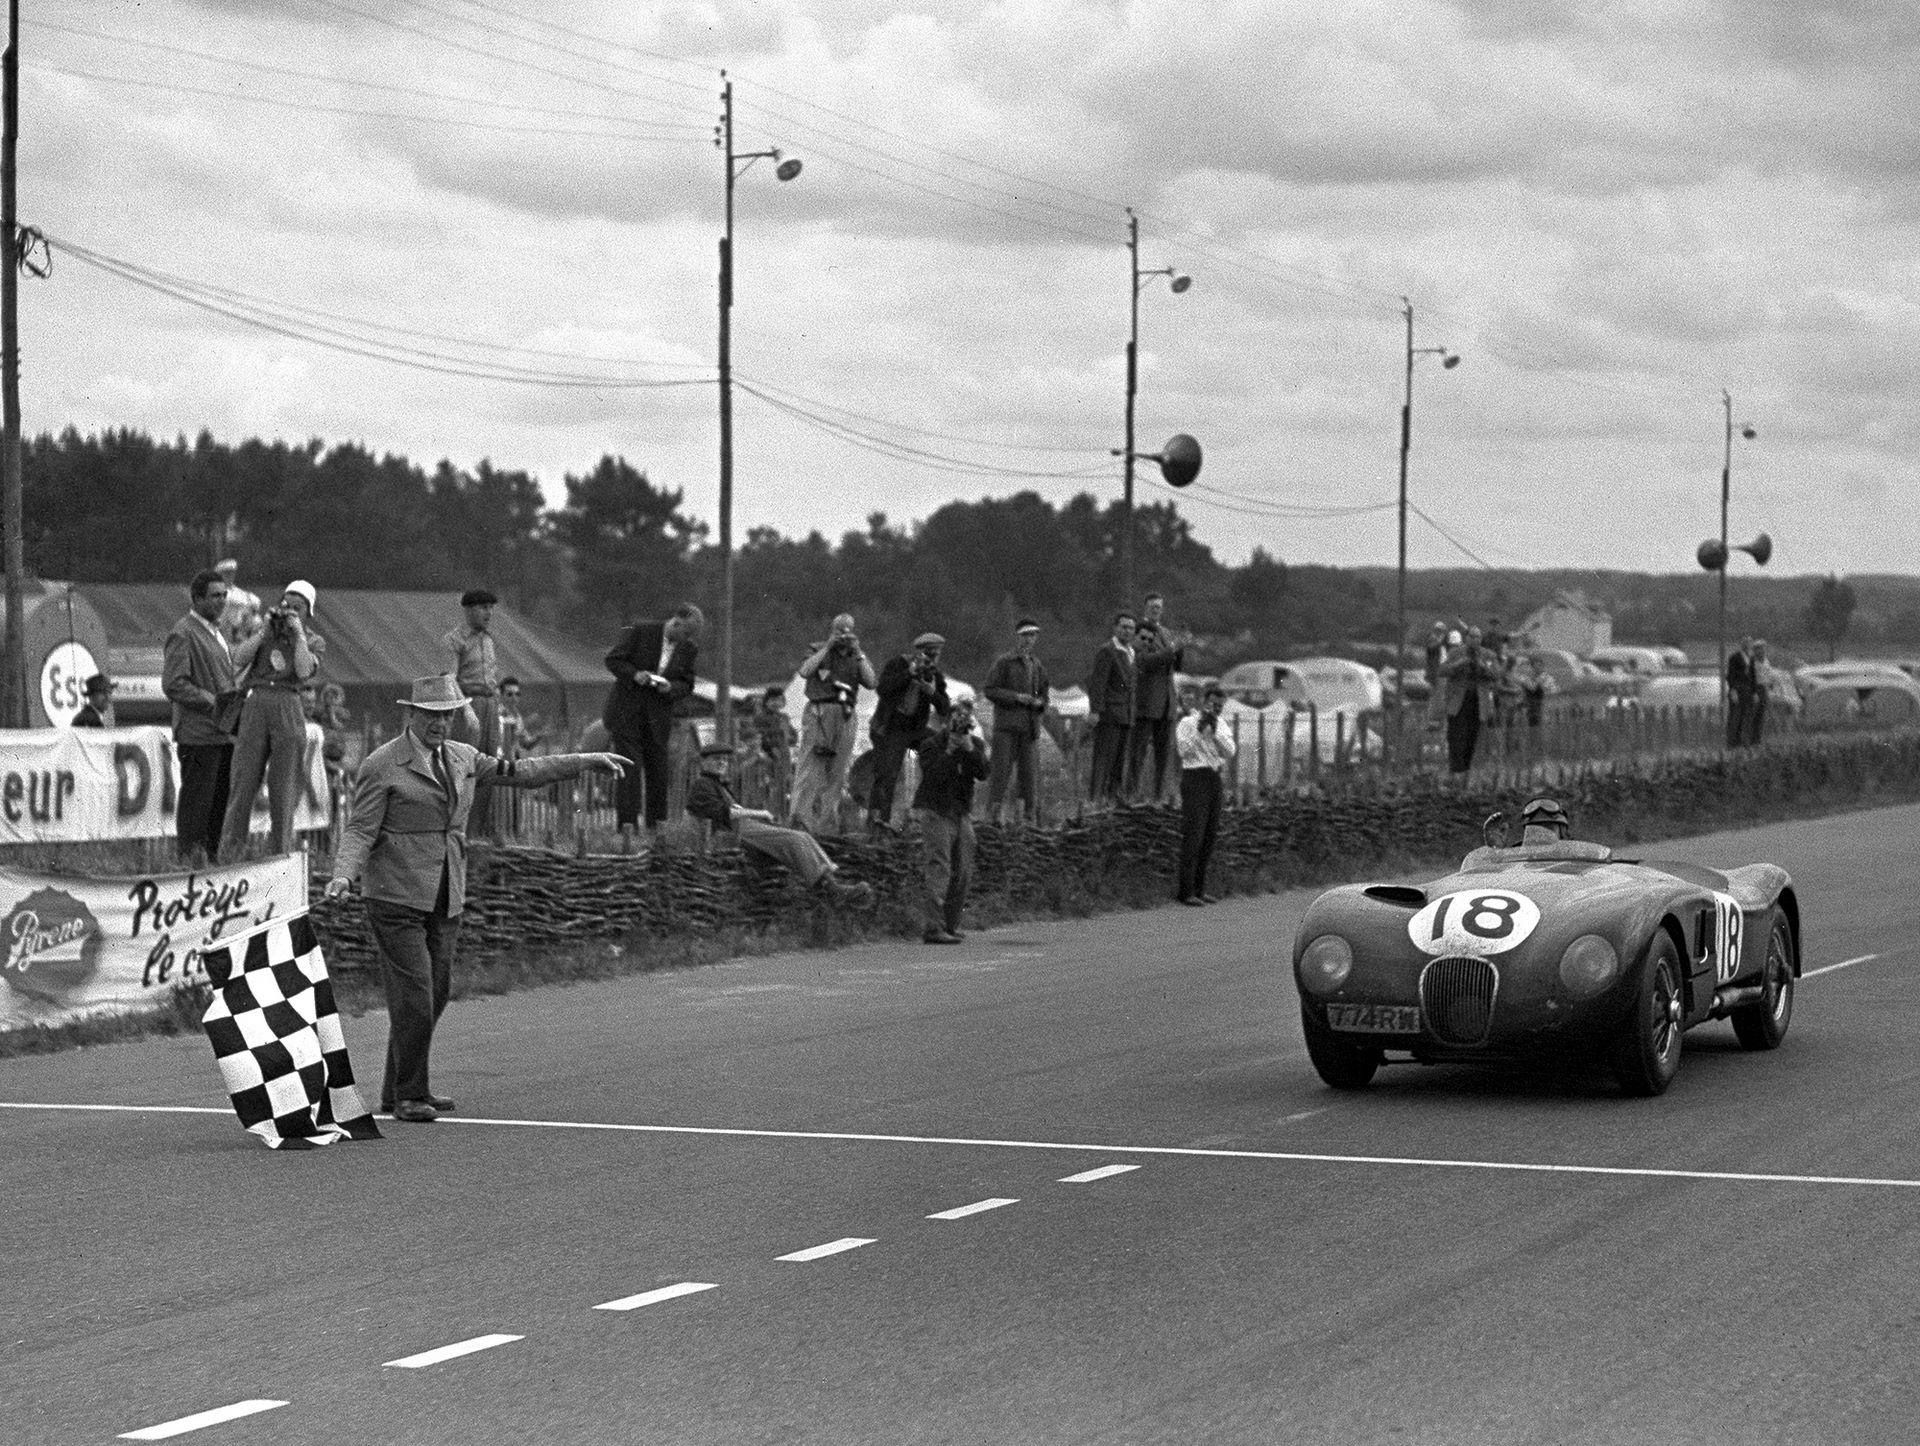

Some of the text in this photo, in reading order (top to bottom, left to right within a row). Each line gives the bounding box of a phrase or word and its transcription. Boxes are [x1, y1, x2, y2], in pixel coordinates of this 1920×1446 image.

[50, 663, 88, 710] Es
[128, 874, 251, 938] Protège
[1431, 895, 1521, 941] 18
[142, 933, 175, 987] le
[1721, 902, 1739, 979] 18
